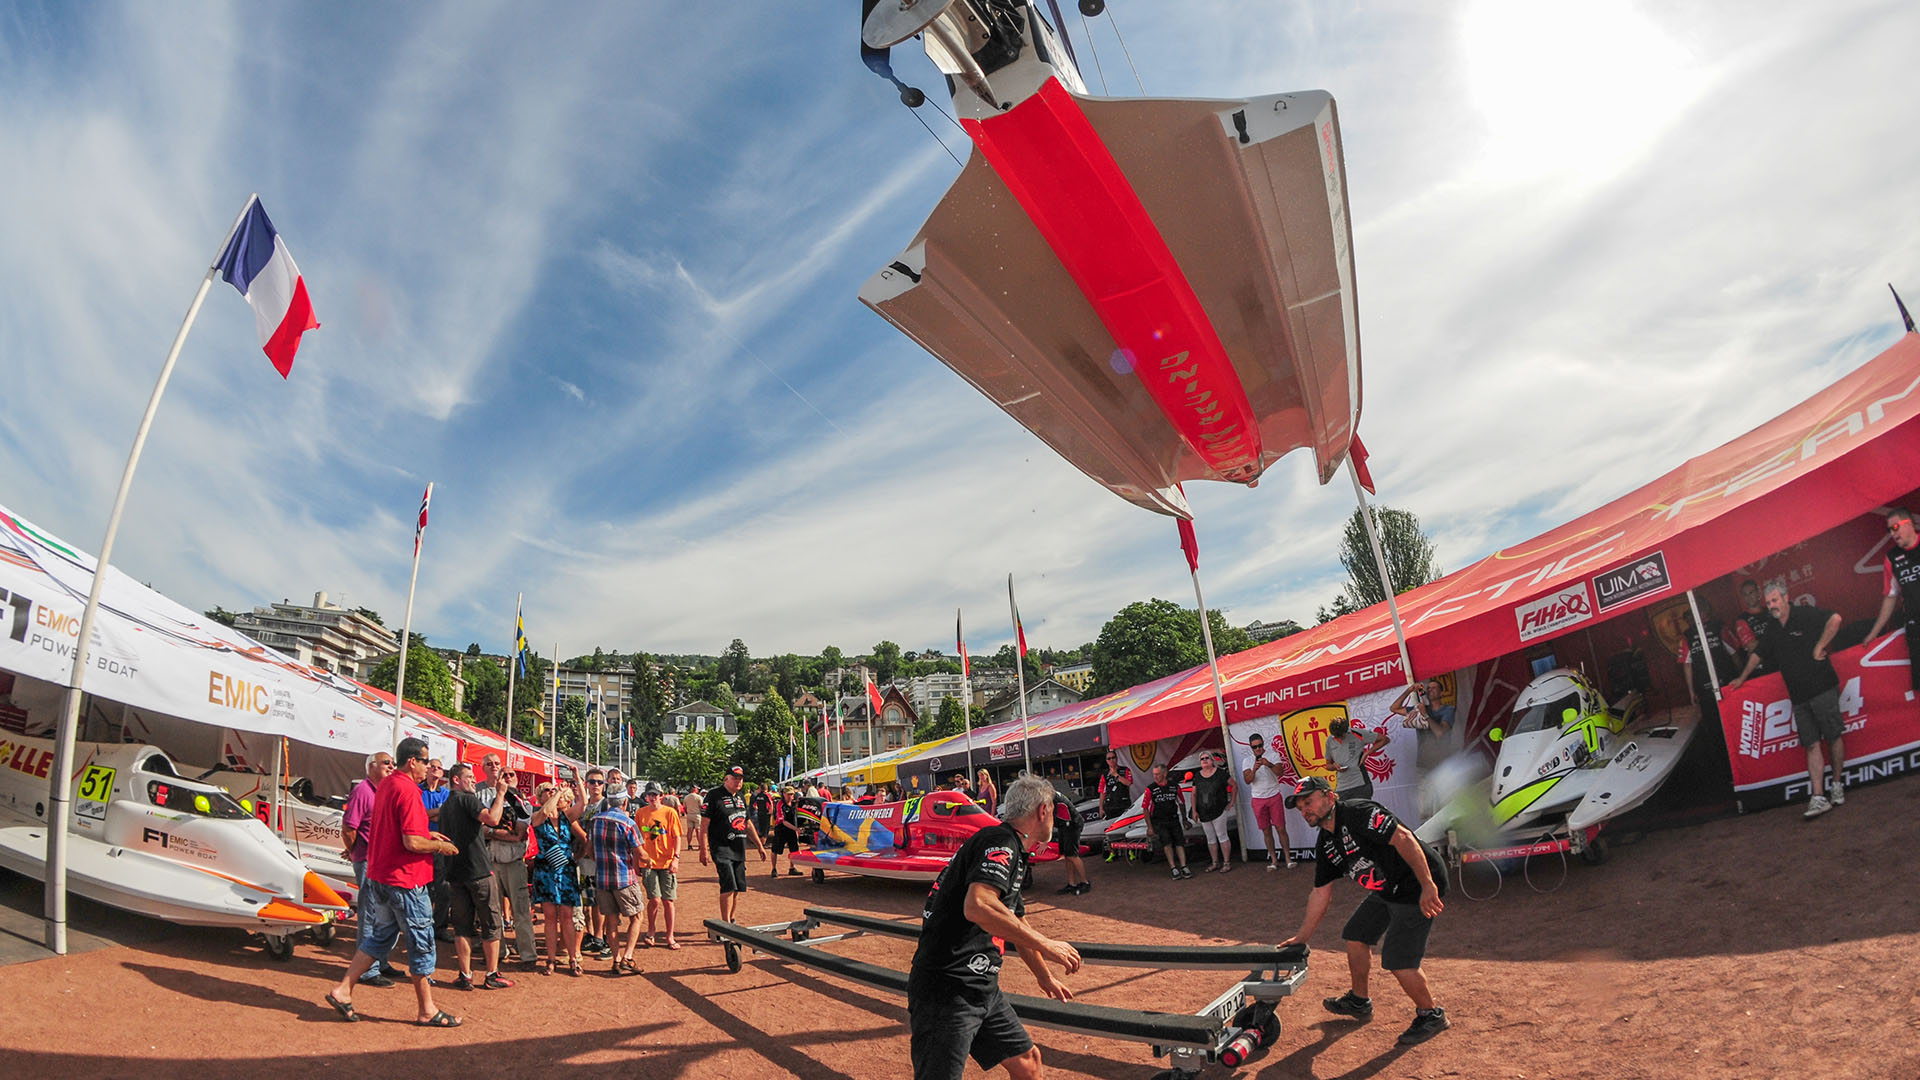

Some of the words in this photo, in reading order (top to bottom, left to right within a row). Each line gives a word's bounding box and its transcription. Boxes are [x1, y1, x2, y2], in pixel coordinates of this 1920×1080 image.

[1600, 570, 1639, 597] UIM
[36, 605, 80, 637] EMIC
[98, 657, 138, 679] BOAT
[208, 670, 270, 715] EMIC
[1244, 687, 1294, 709] CHINA
[1298, 675, 1340, 697] CTIC
[1345, 658, 1402, 684] TEAM
[1738, 699, 1754, 755] WORLD
[81, 768, 112, 800] 51
[1785, 781, 1812, 800] F1
[870, 807, 894, 819] SWEDEN
[143, 827, 168, 848] F1
[169, 835, 188, 847] EMIC
[169, 845, 194, 856] POWER
[197, 852, 217, 861] BOAT
[1234, 991, 1245, 1012] 12
